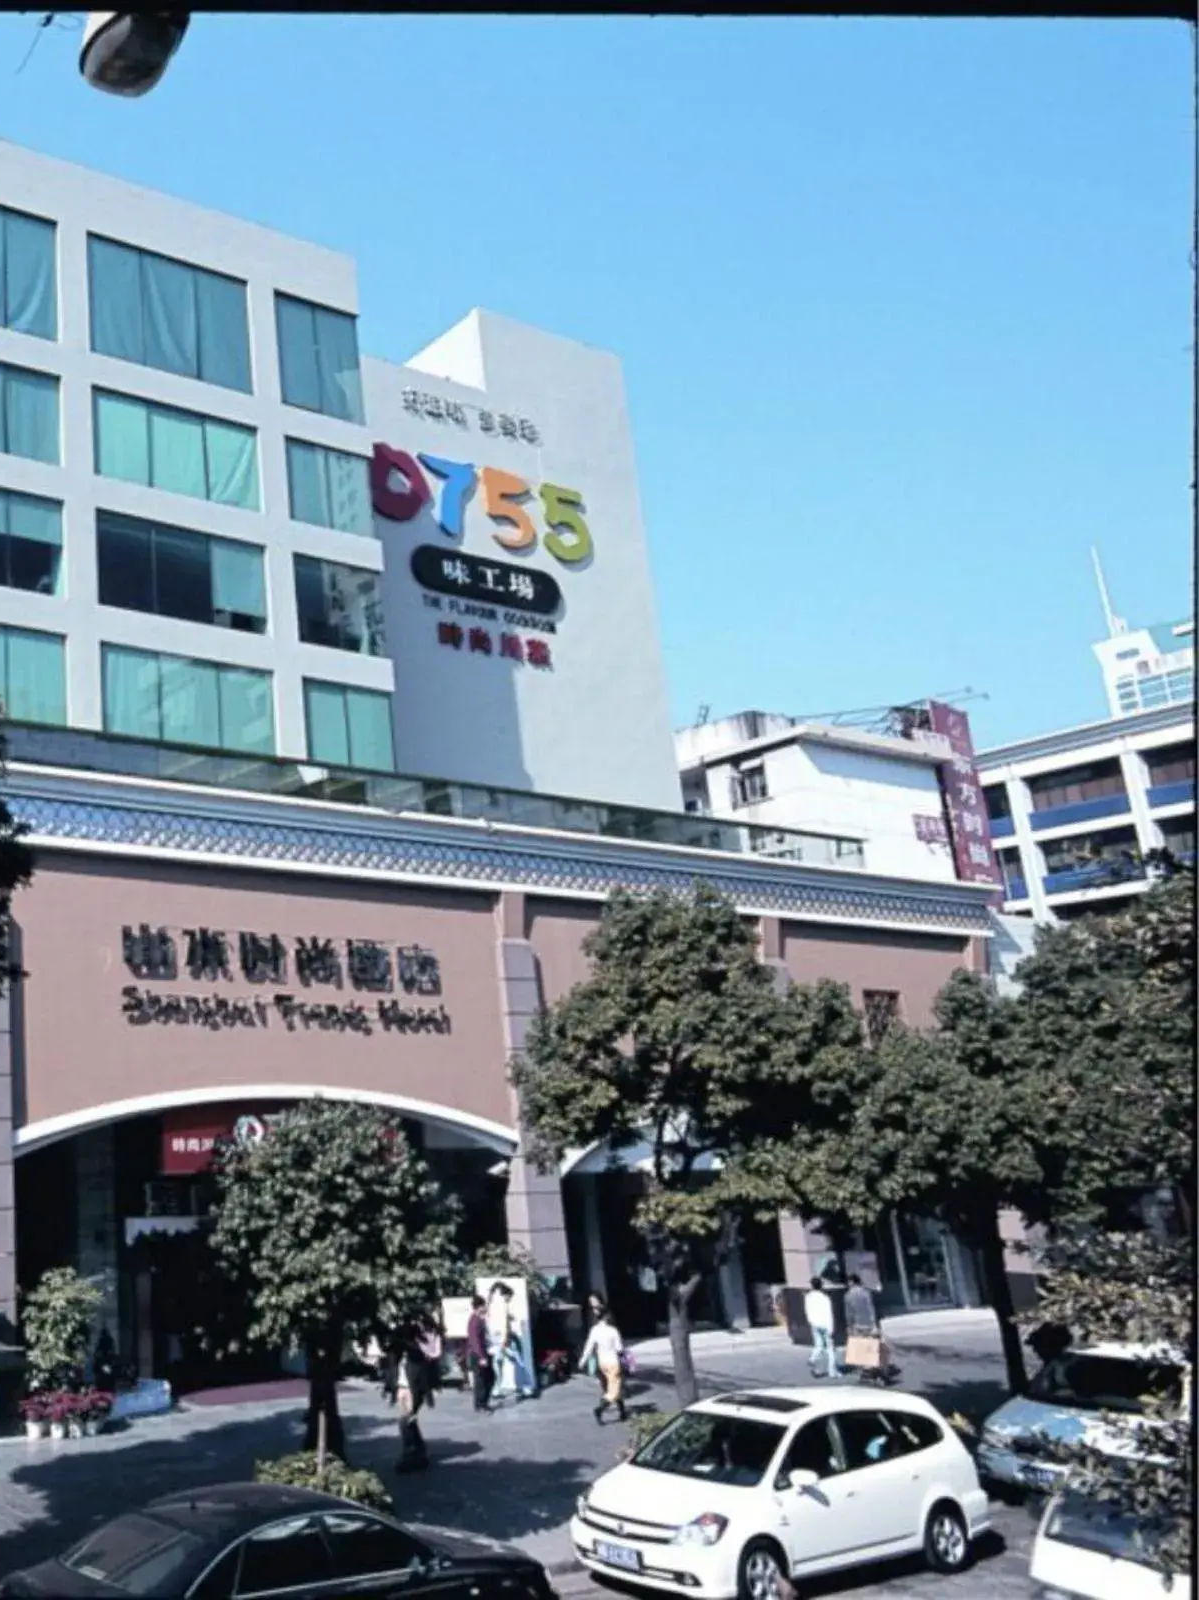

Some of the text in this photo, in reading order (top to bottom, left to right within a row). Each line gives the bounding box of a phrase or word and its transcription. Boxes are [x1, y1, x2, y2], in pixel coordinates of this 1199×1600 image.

[370, 441, 594, 563] 0755
[441, 558, 535, 601] 味工場
